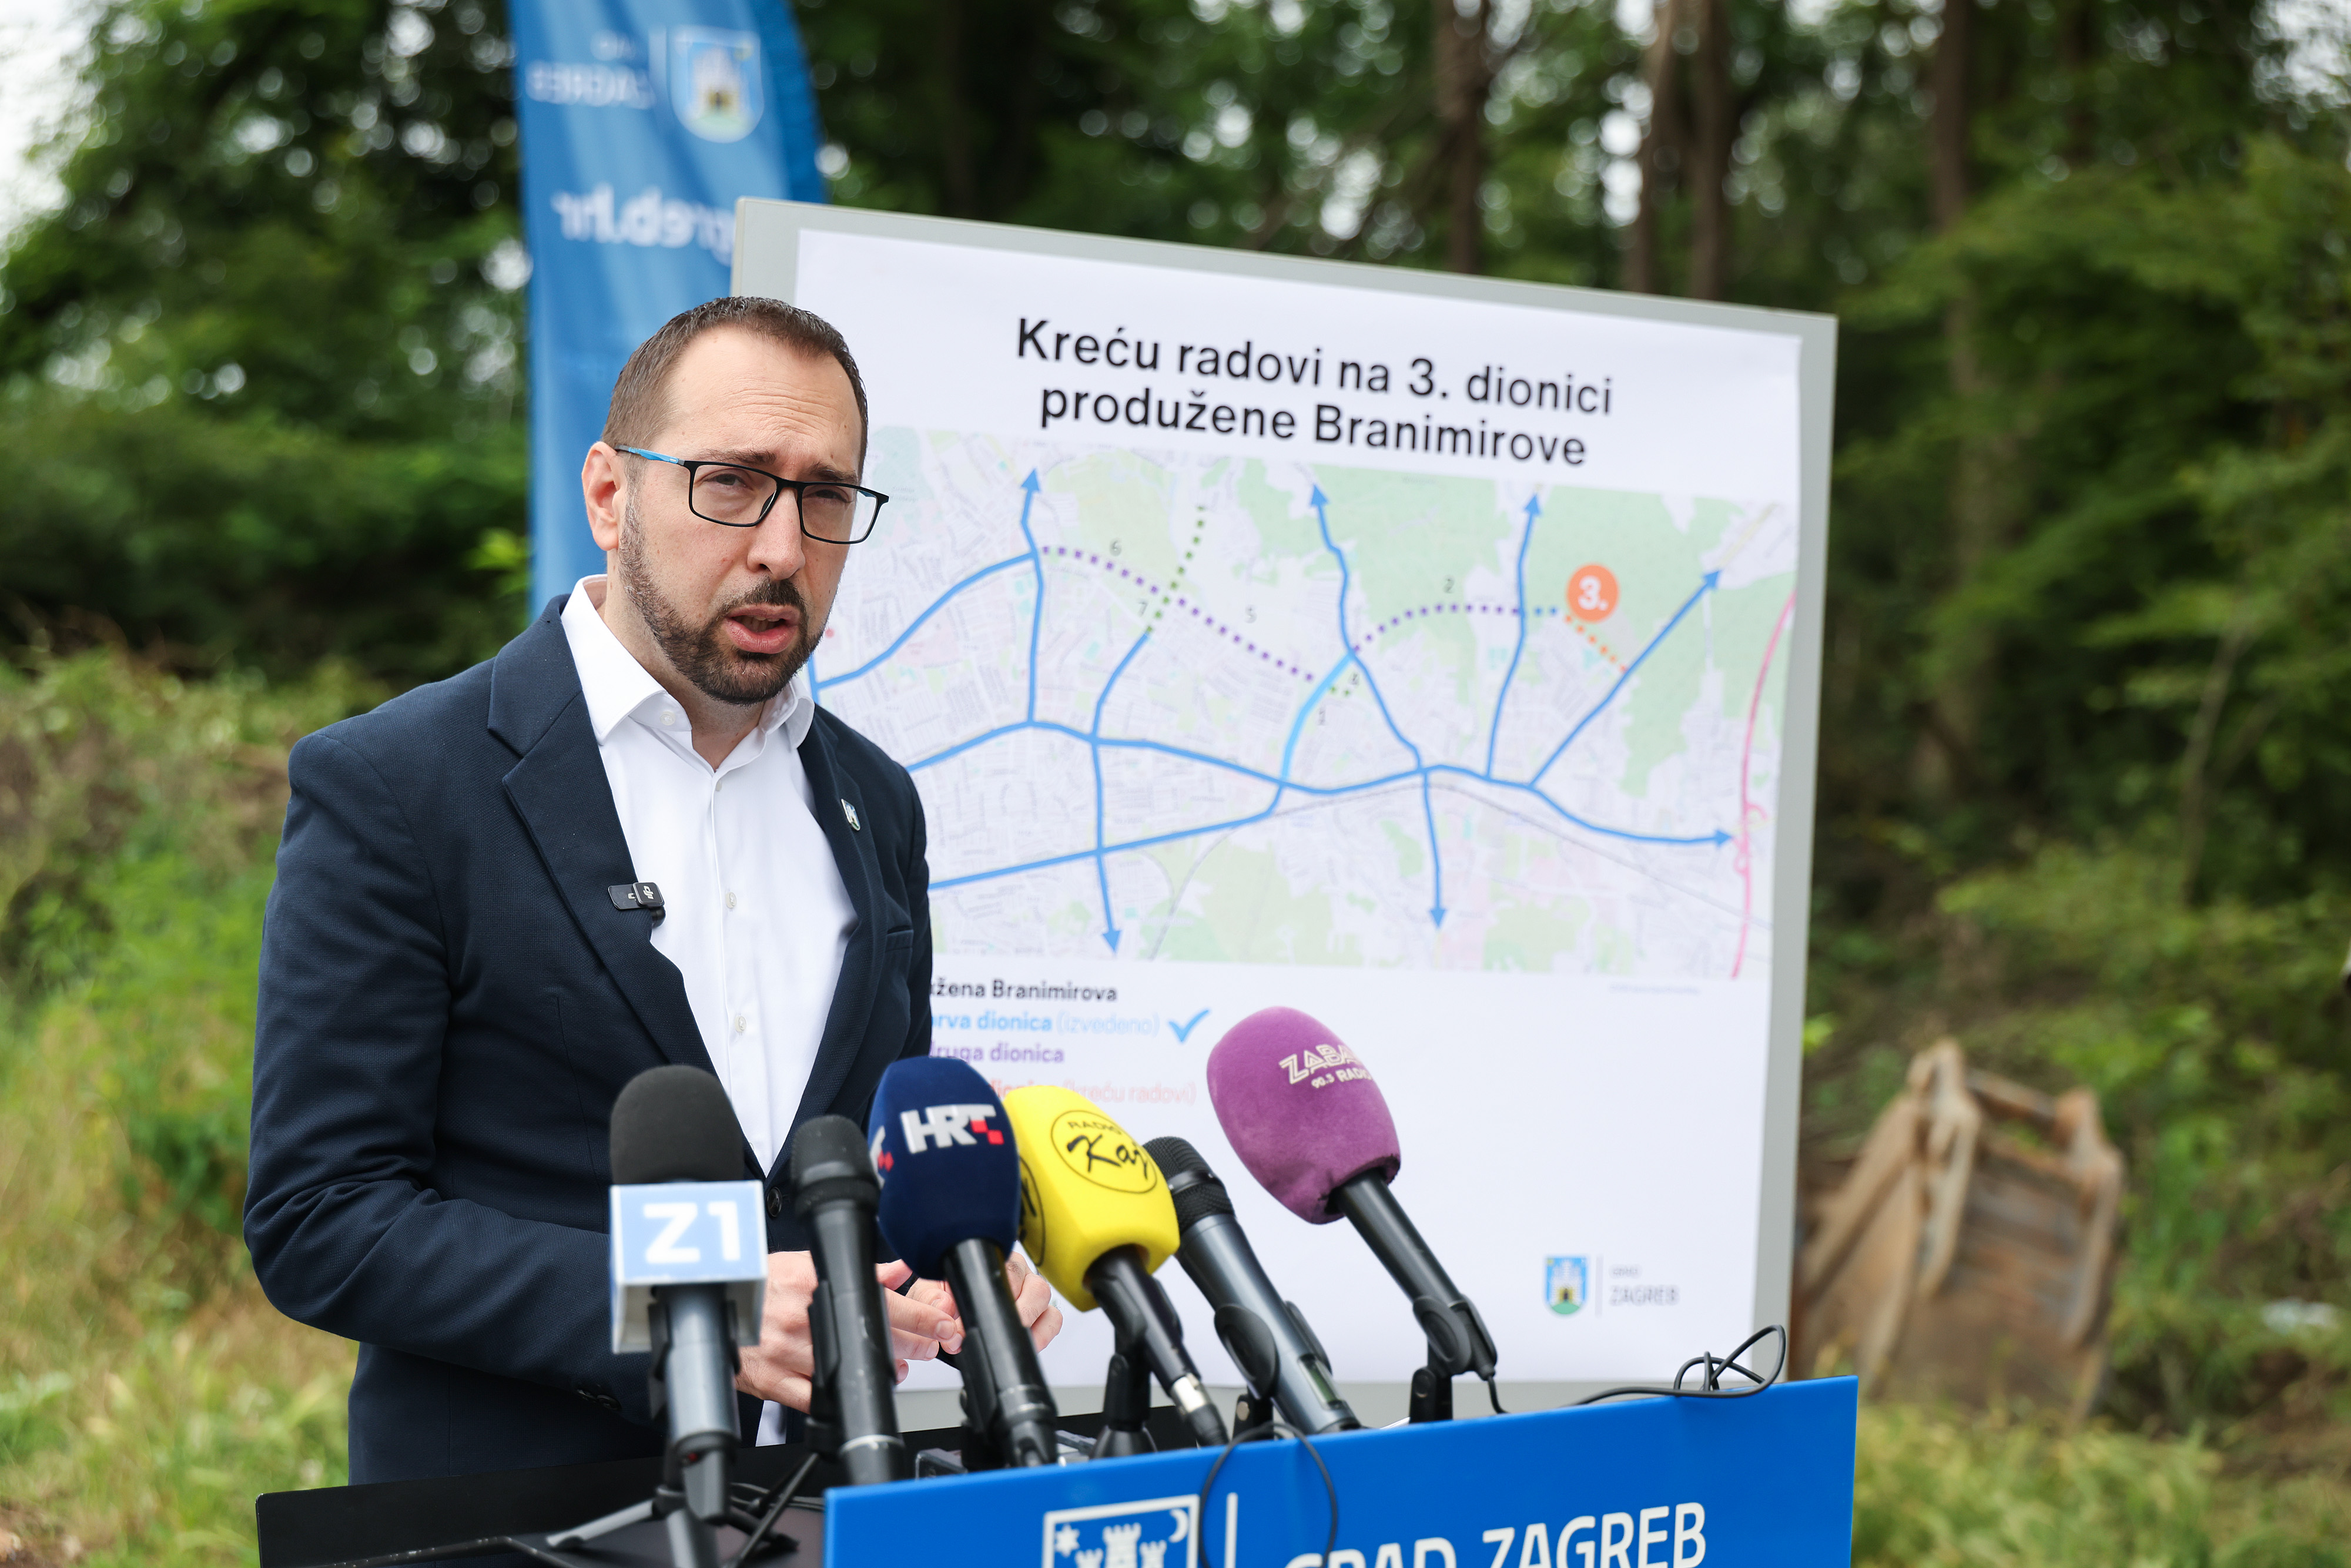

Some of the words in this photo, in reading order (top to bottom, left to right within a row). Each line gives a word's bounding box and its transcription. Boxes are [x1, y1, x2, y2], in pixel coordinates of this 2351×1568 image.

[1017, 318, 1159, 370] Kreću
[1178, 340, 1321, 386] radovi
[1340, 361, 1389, 393] na
[1409, 358, 1448, 398] 3.
[1469, 365, 1612, 414] dionici
[1041, 387, 1295, 438] produžene
[1315, 404, 1585, 465] Branimirove
[1578, 575, 1609, 611] 3.
[992, 979, 1118, 1000] Branimirova
[977, 1010, 1053, 1032] dionica
[1057, 1011, 1160, 1036] (izvedeno)
[990, 1041, 1065, 1064] dionica
[900, 1104, 1004, 1154] HRT
[643, 1201, 741, 1263] Z1
[1482, 1502, 1706, 1568] ZAGREB
